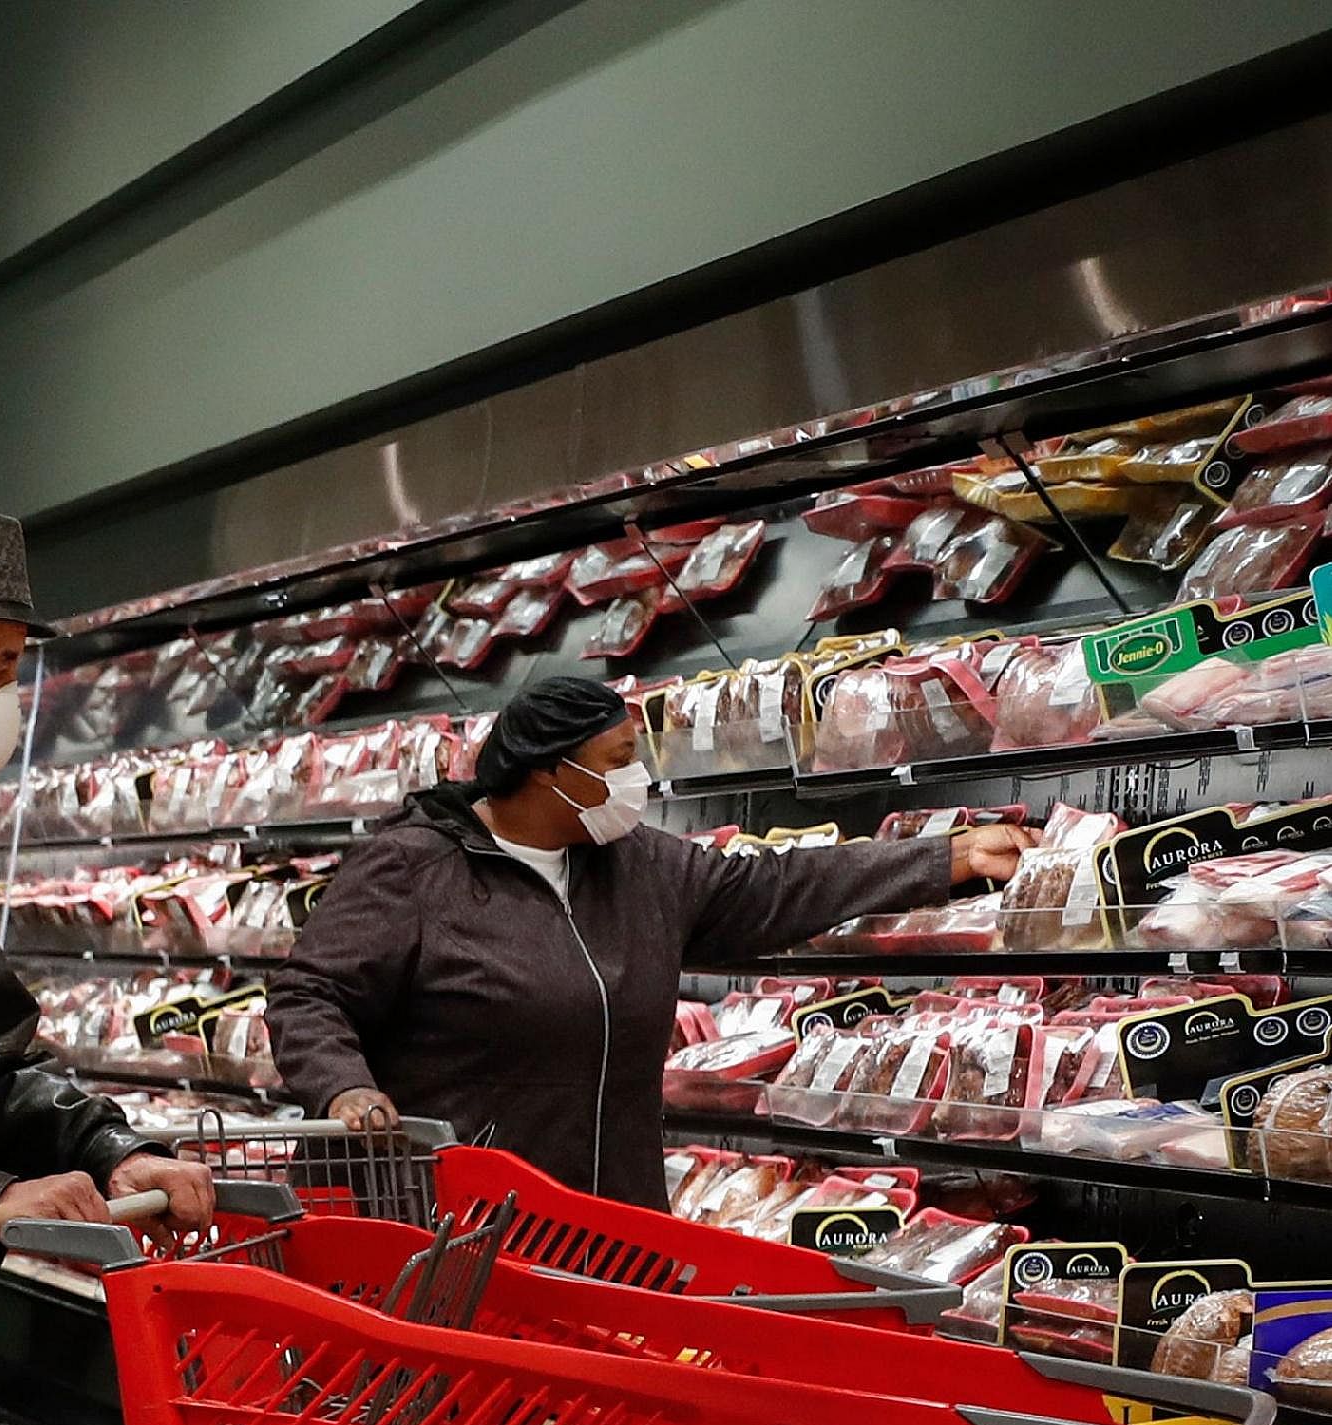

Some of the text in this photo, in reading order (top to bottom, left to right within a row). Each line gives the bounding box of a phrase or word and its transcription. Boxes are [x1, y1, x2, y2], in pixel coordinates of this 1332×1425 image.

[1117, 642, 1164, 666] Jennie-O
[1153, 839, 1223, 870] AURORA
[1190, 1017, 1235, 1035] AURORA
[821, 1231, 888, 1246] AURORA
[1069, 1265, 1110, 1275] AURORA
